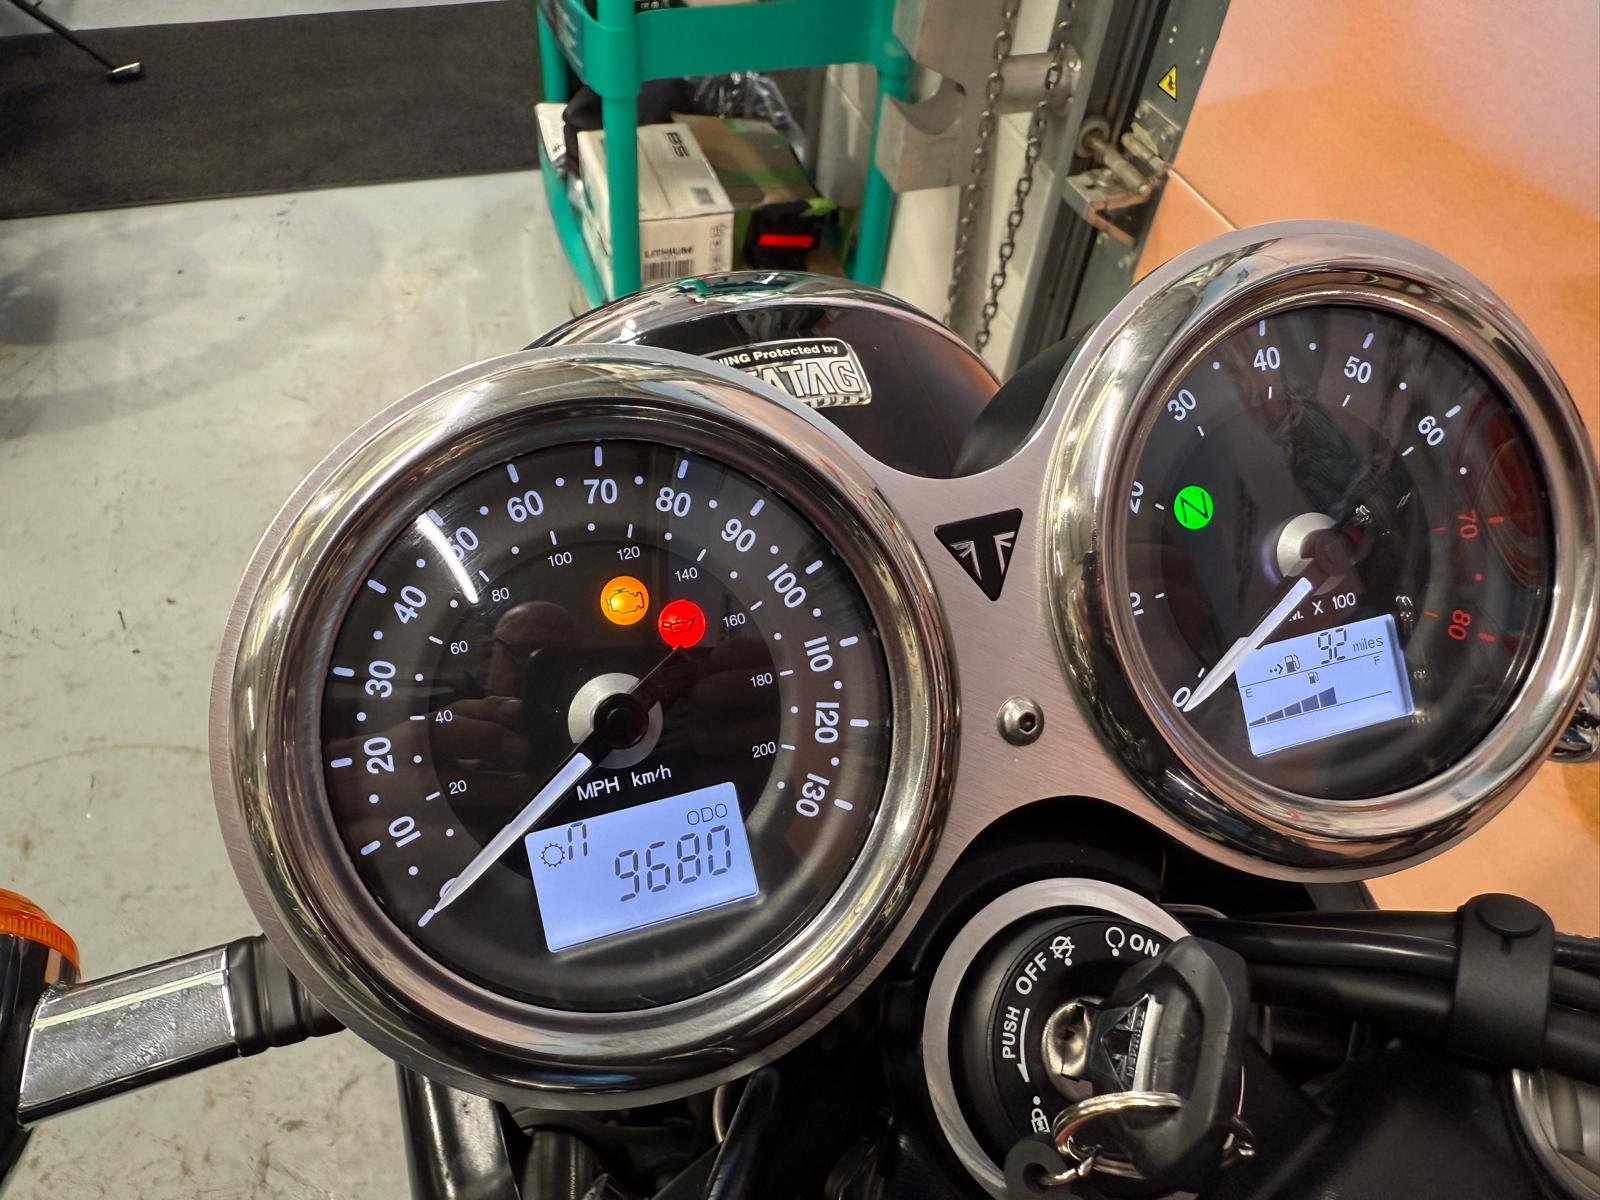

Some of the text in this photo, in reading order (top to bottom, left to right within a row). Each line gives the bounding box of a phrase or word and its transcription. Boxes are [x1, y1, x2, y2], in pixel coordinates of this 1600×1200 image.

[752, 345, 820, 362] Protected
[822, 343, 838, 356] by
[1253, 346, 1281, 371] 40
[1343, 355, 1372, 384] 50
[1167, 388, 1197, 421] 30
[1418, 415, 1445, 446] 60
[507, 490, 544, 523] 60
[583, 478, 618, 505] 70
[655, 486, 691, 517] 80
[721, 518, 756, 552] 90
[1456, 508, 1478, 539] 70
[547, 551, 572, 568] 100
[616, 546, 641, 561] 120
[674, 566, 698, 583] 140
[767, 562, 807, 608] 100
[393, 585, 427, 624] 40
[491, 587, 510, 603] 80
[1311, 601, 1324, 616] X
[1331, 592, 1357, 610] 100
[722, 612, 746, 628] 160
[1447, 608, 1472, 641] 80
[450, 639, 468, 655] 60
[804, 636, 833, 672] 110
[1317, 627, 1384, 665] 92 miles
[1373, 655, 1381, 666] F
[364, 660, 396, 698] 30
[750, 672, 773, 688] 180
[1245, 688, 1254, 699] E
[1172, 686, 1191, 708] 0
[435, 710, 453, 724] 40
[814, 701, 840, 744] 120
[363, 736, 395, 774] 20
[752, 741, 776, 758] 200
[449, 780, 467, 795] 20
[576, 765, 672, 801] MPH km/h
[795, 773, 830, 818] 130
[686, 803, 729, 826] ODO
[388, 815, 422, 847] 10
[614, 825, 731, 901] 9680
[1128, 933, 1160, 957] ON
[1015, 952, 1048, 995] OFF
[1002, 1006, 1021, 1059] PUSH
